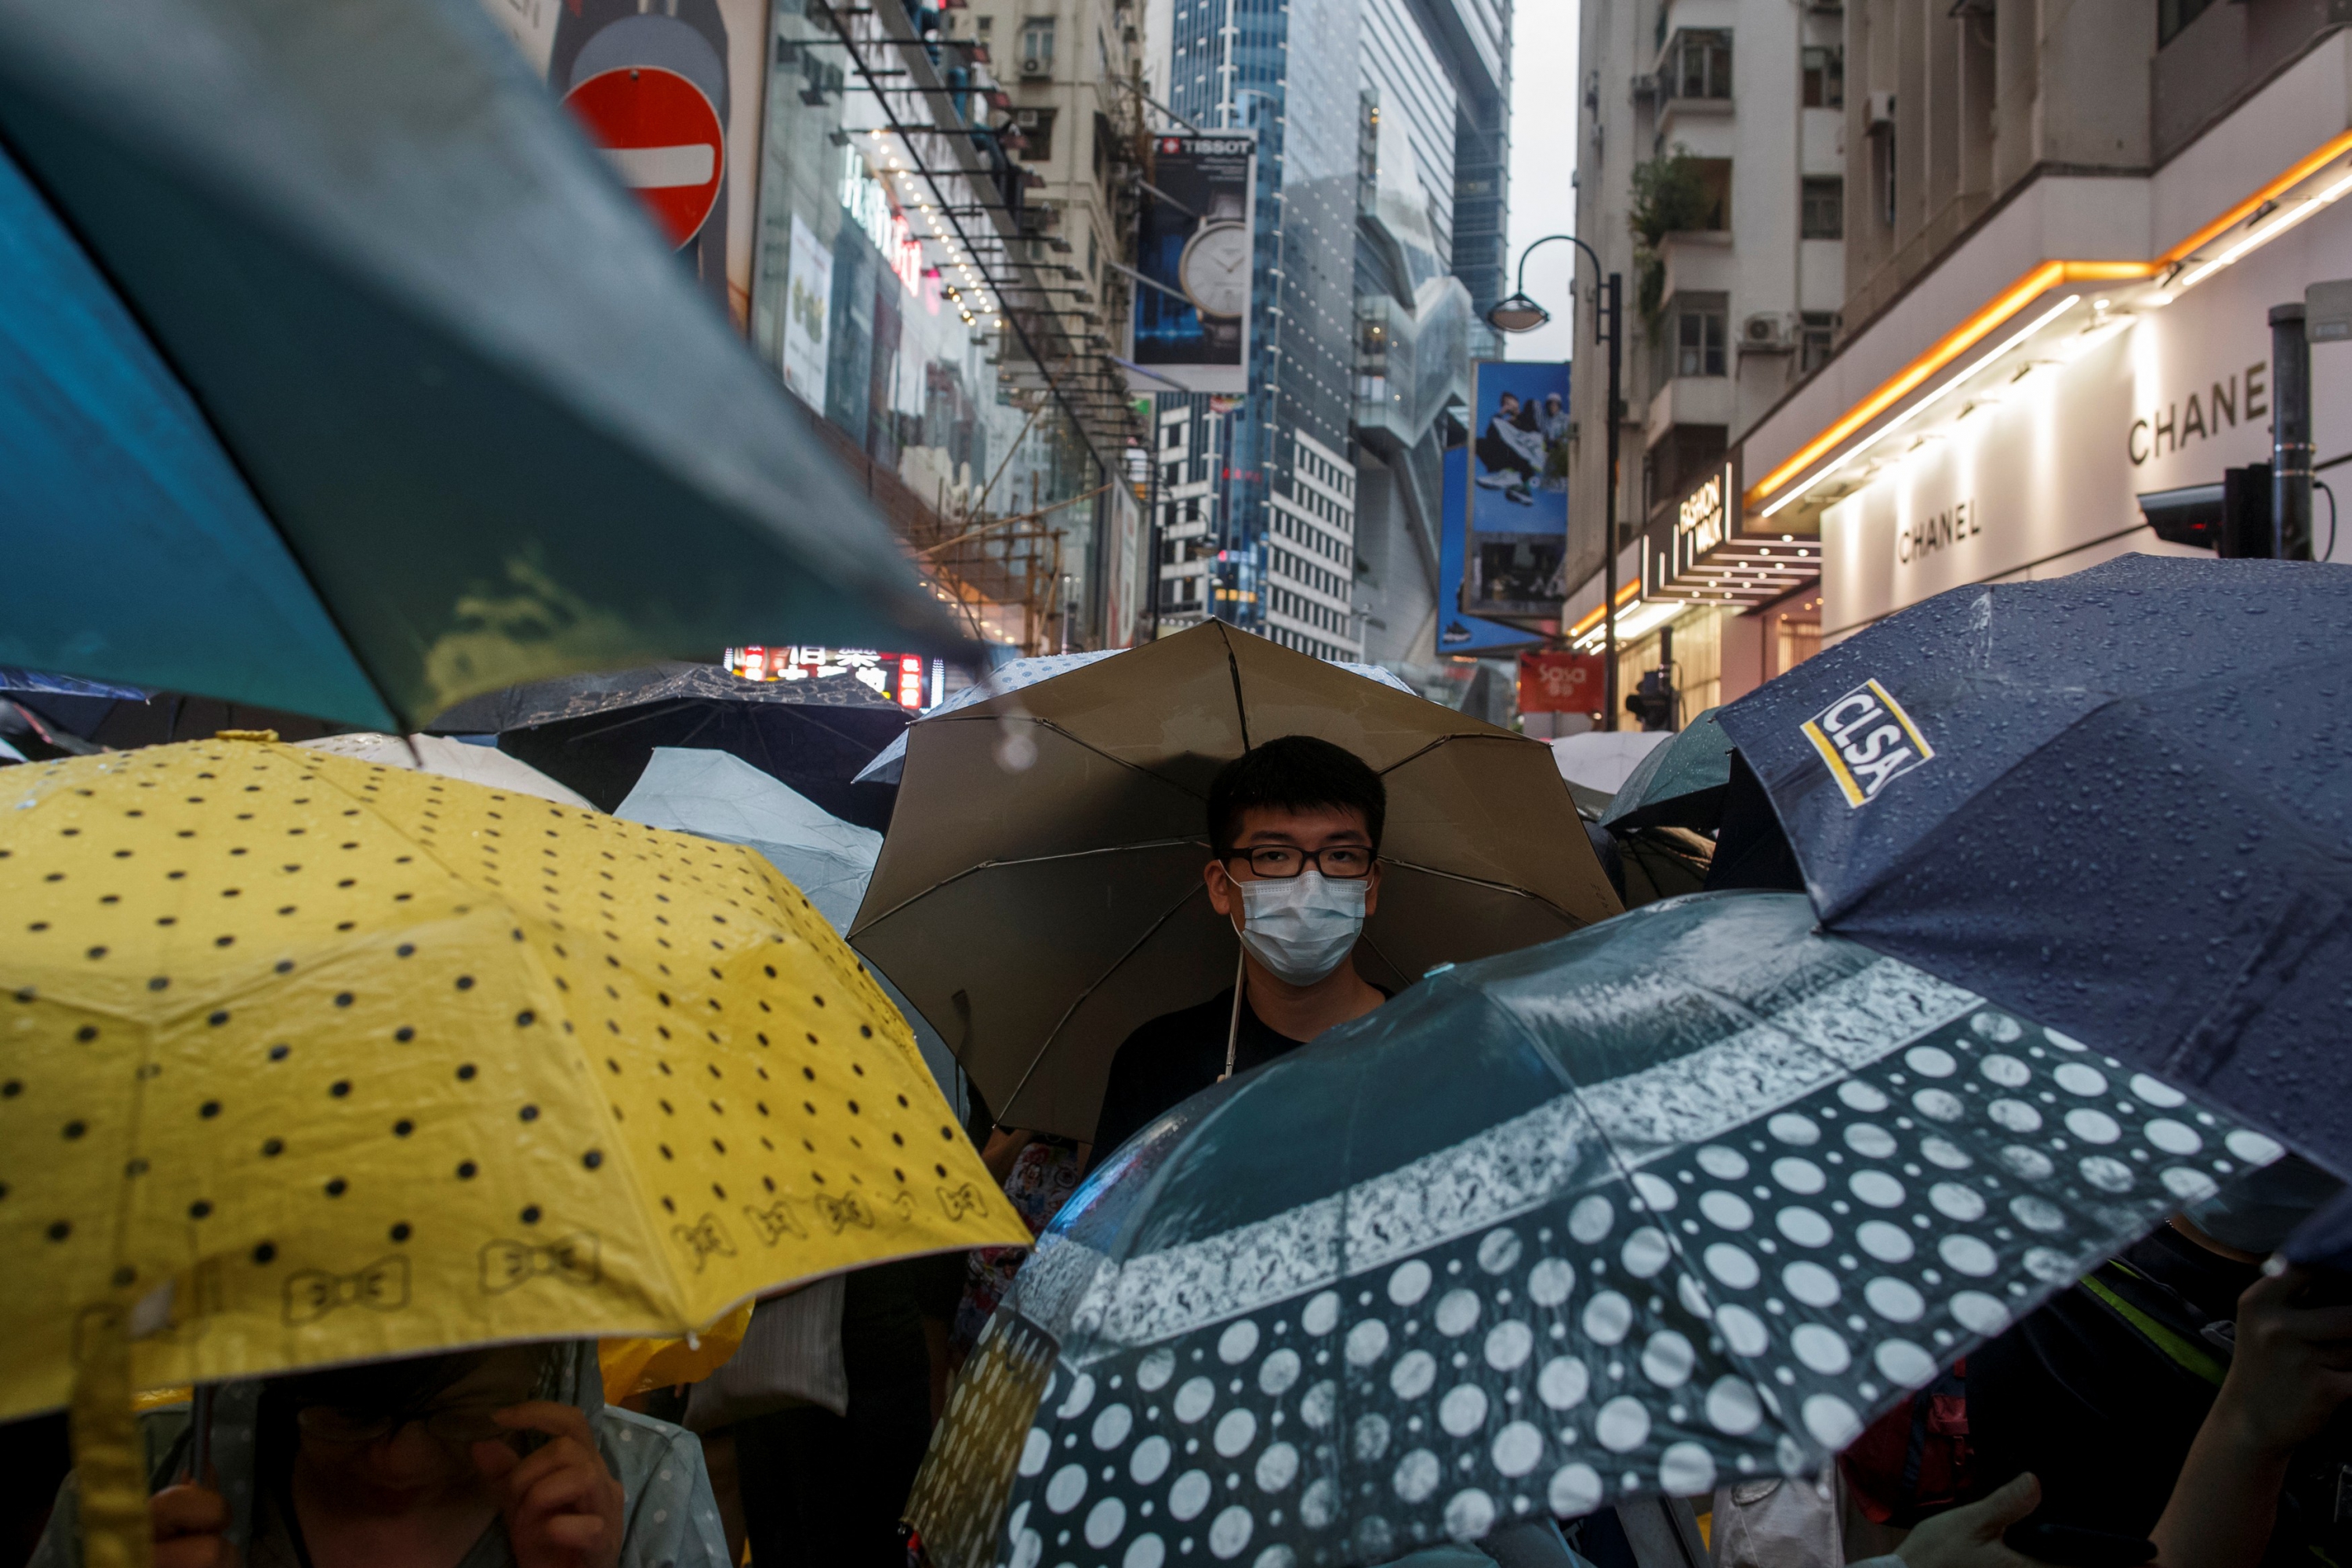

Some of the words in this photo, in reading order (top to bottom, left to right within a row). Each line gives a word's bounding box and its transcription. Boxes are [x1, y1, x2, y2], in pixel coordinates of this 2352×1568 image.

[1182, 140, 1250, 154] TISSOT
[2128, 361, 2267, 466] CHANE
[1898, 499, 1982, 564] CHANEL
[1823, 694, 1911, 795] CLSA
